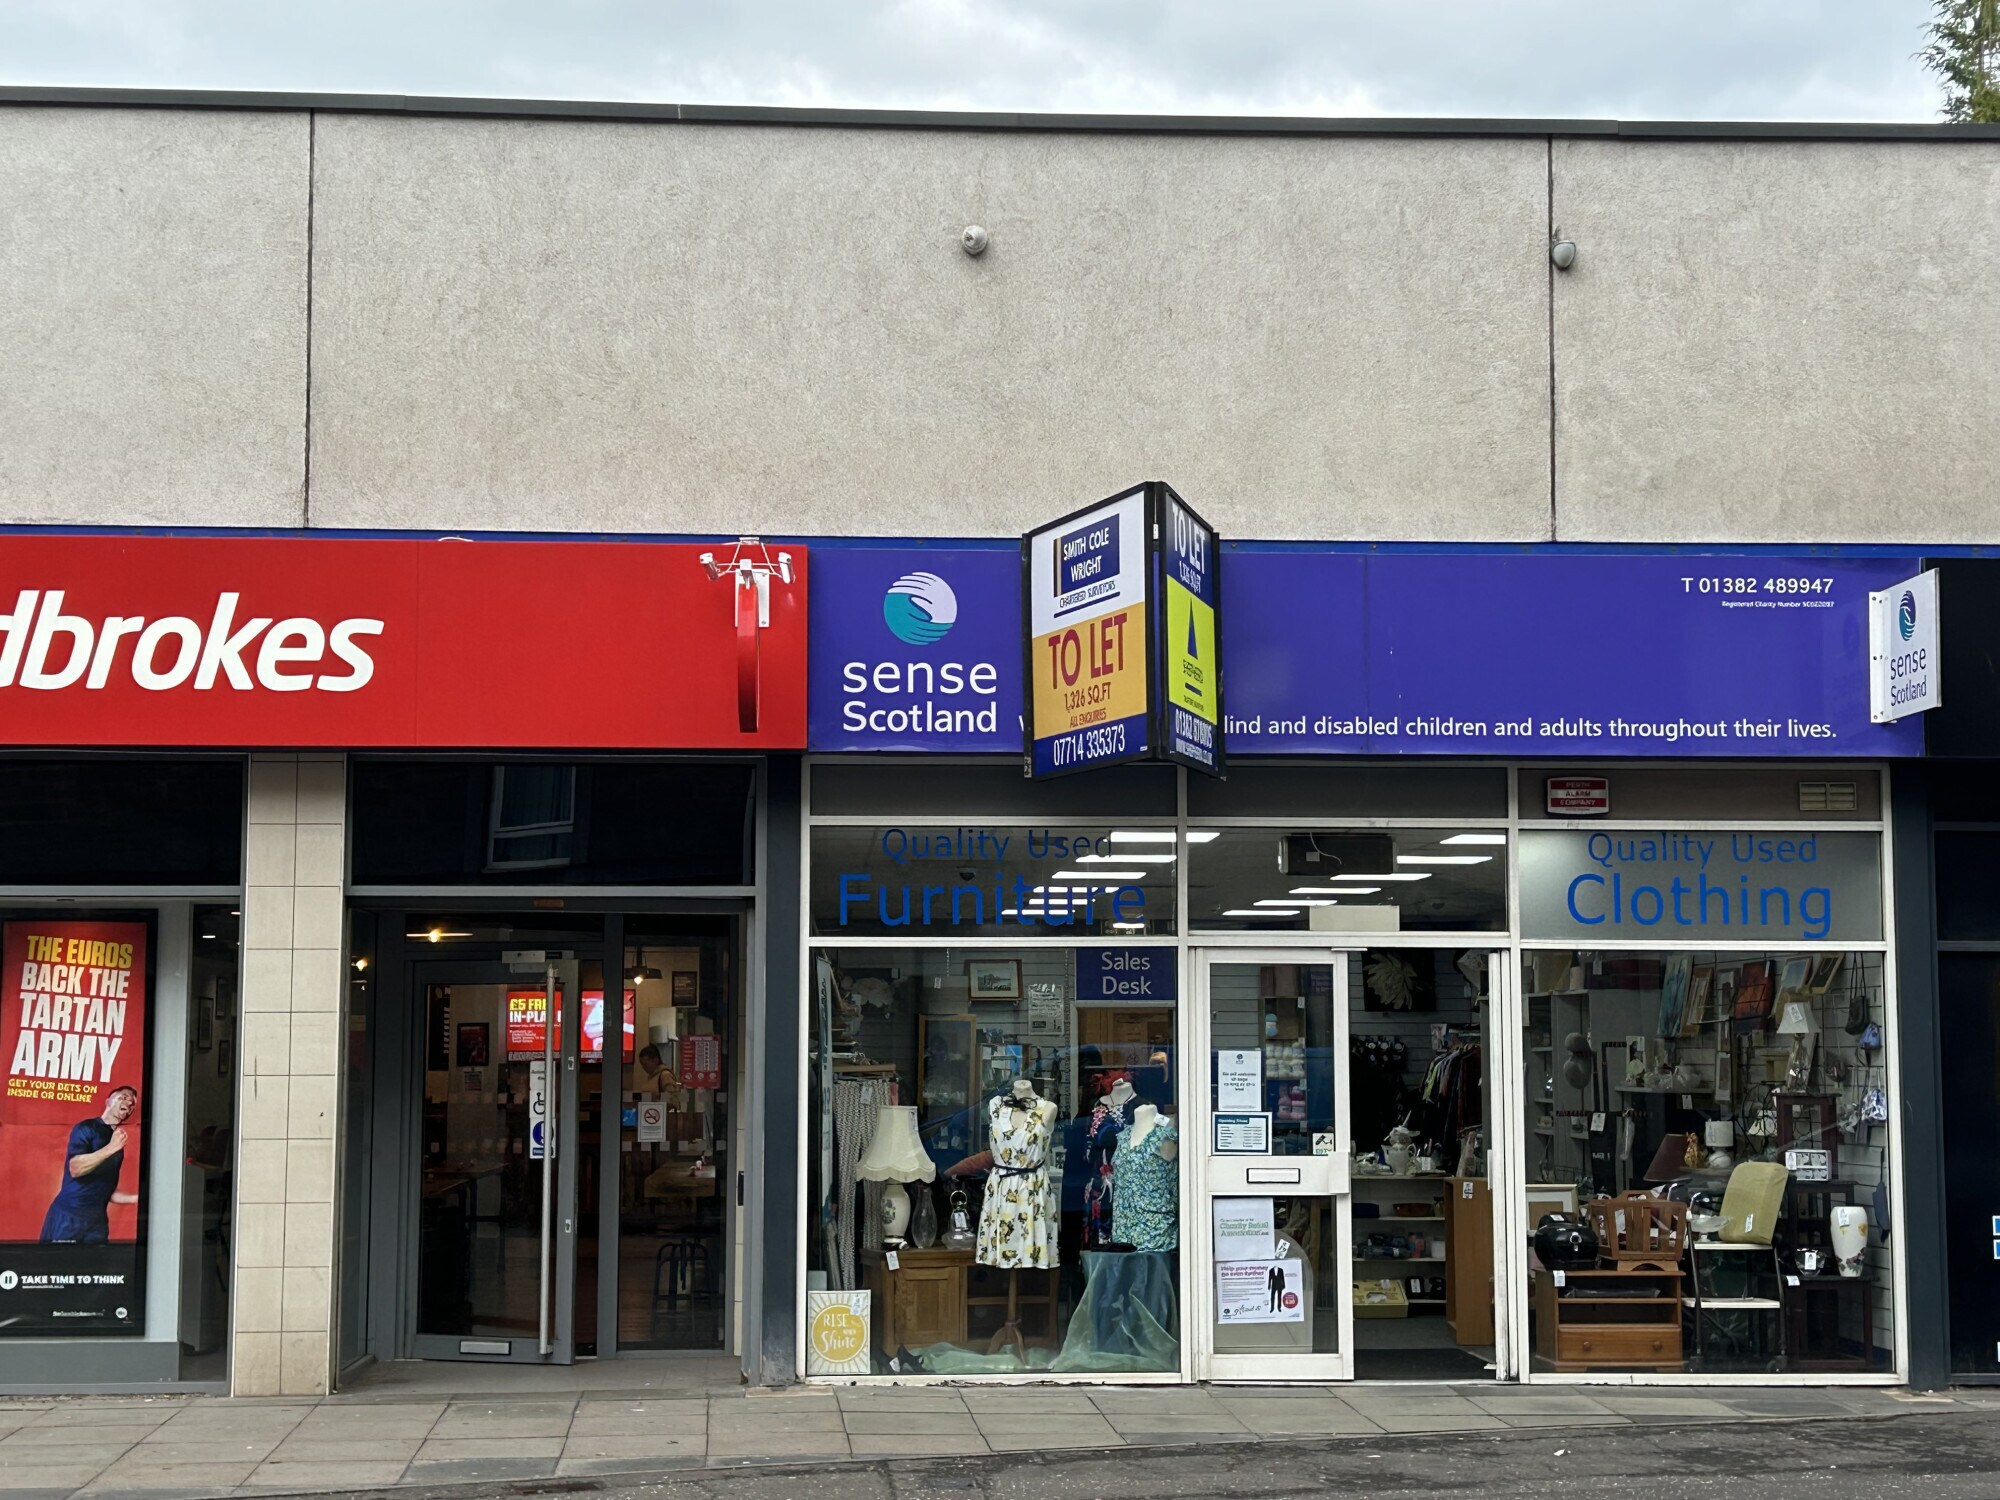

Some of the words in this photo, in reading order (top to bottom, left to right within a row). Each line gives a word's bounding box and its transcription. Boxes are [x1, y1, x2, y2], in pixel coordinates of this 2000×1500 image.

[1063, 540, 1087, 561] SMITH
[1088, 527, 1109, 550] COLE
[1172, 501, 1187, 558] TO
[1188, 518, 1206, 575] LET
[1070, 555, 1102, 582] WRIGHT
[1681, 577, 1693, 593] T
[1699, 577, 1758, 594] 01382
[1763, 577, 1834, 594] 489947
[1721, 601, 1754, 609] Registered
[1755, 601, 1776, 609] Charity
[1048, 628, 1081, 690] TO
[1089, 612, 1128, 679] LET
[1890, 648, 1927, 680] sense
[843, 661, 997, 695] sense
[1890, 675, 1927, 706] Scotland
[843, 700, 997, 733] Scotland
[1064, 688, 1086, 713] 1,326
[1053, 732, 1084, 766] 07714
[1086, 723, 1126, 759] 335373
[1224, 715, 1261, 734] lind
[1268, 715, 1307, 735] and
[1313, 715, 1399, 735] disabled
[1405, 716, 1487, 736] children
[1494, 717, 1533, 736] and
[1539, 717, 1602, 737] adults
[1608, 718, 1727, 742] throughout
[1733, 718, 1782, 737] their
[1787, 719, 1837, 738] lives.
[882, 828, 1009, 864] Quality
[1028, 829, 1113, 859] Used
[1588, 832, 1714, 869] Quality
[1732, 833, 1818, 864] Used
[839, 872, 1146, 927] Furniture
[1567, 873, 1832, 939] Clothing
[27, 935, 63, 963] THE
[66, 938, 133, 969] EUROS
[1101, 951, 1151, 971] Sales
[20, 961, 85, 995] BACK
[89, 968, 131, 999] THE
[1102, 975, 1152, 996] Desk
[19, 991, 127, 1036] TARTAN
[510, 1010, 547, 1023] IN-PLA
[9, 1030, 123, 1083] ARMY
[7, 1087, 39, 1098] INSIDE
[40, 1091, 55, 1100] OR
[56, 1092, 92, 1103] ONLINE
[8, 1078, 28, 1088] GET
[29, 1080, 55, 1090] YOUR
[57, 1083, 82, 1093] BETS
[82, 1085, 98, 1094] ON
[21, 1275, 48, 1284] TAKE
[50, 1275, 75, 1284] TIME
[77, 1275, 92, 1284] TO
[92, 1275, 125, 1284] THINK
[823, 1313, 849, 1328] RISE
